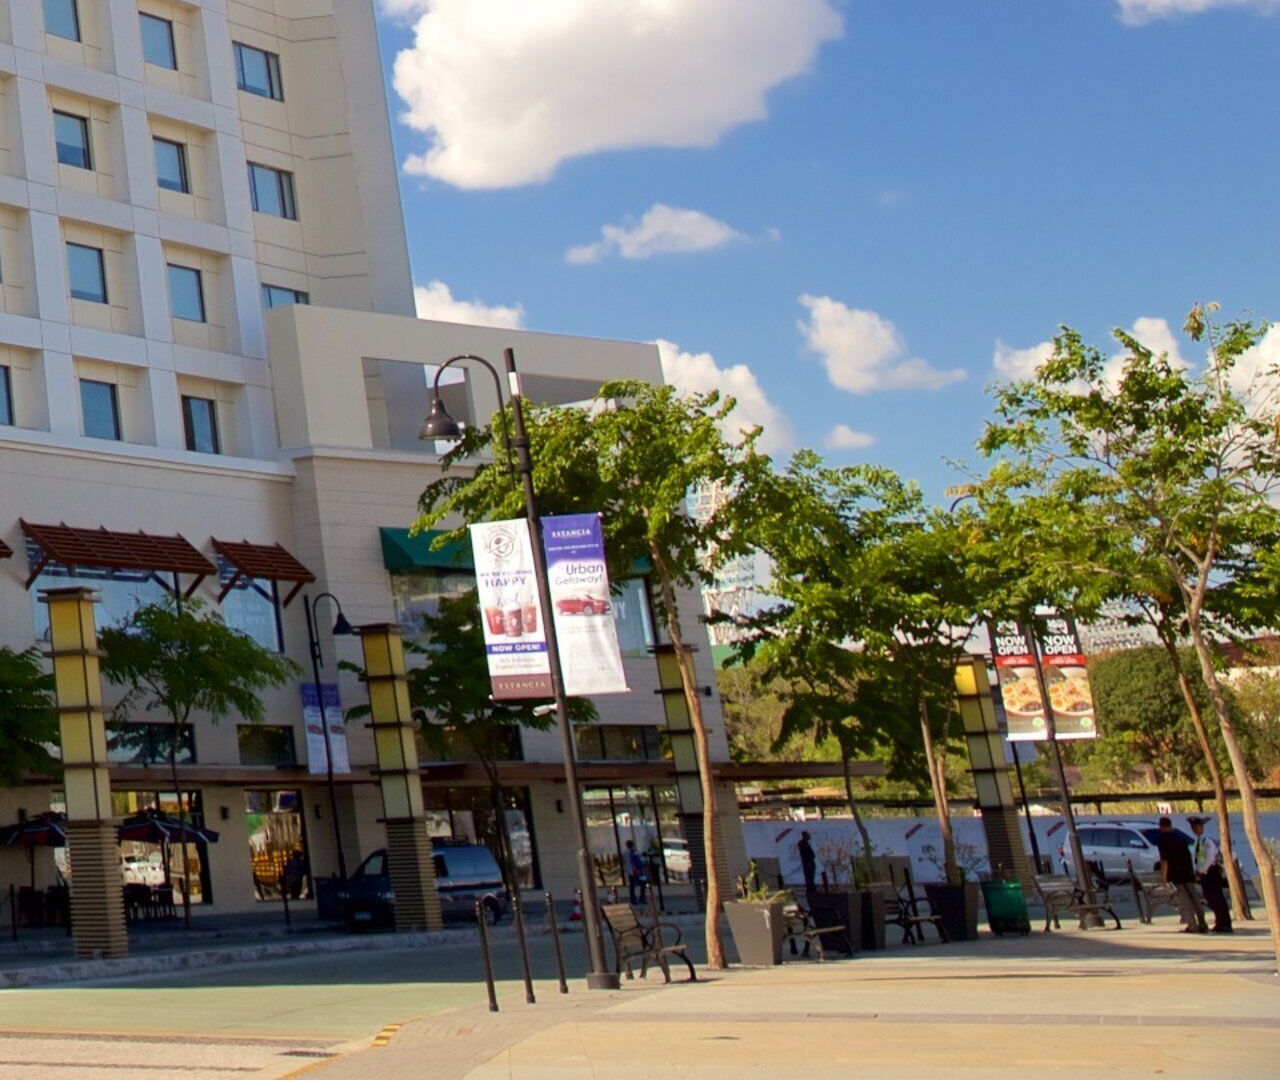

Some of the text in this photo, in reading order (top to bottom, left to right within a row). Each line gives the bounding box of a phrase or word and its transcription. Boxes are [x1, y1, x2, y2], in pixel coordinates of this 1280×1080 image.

[552, 529, 592, 538] ESTANCIA
[566, 564, 604, 575] Urban
[485, 577, 526, 588] HAPPY
[555, 575, 603, 586] Getaway!
[995, 635, 1026, 646] NOW
[1043, 635, 1075, 646] NOW
[515, 643, 541, 651] OPEN!
[998, 645, 1029, 655] OPEN
[1045, 645, 1078, 655] OPEN
[499, 681, 546, 689] ESTANCIA
